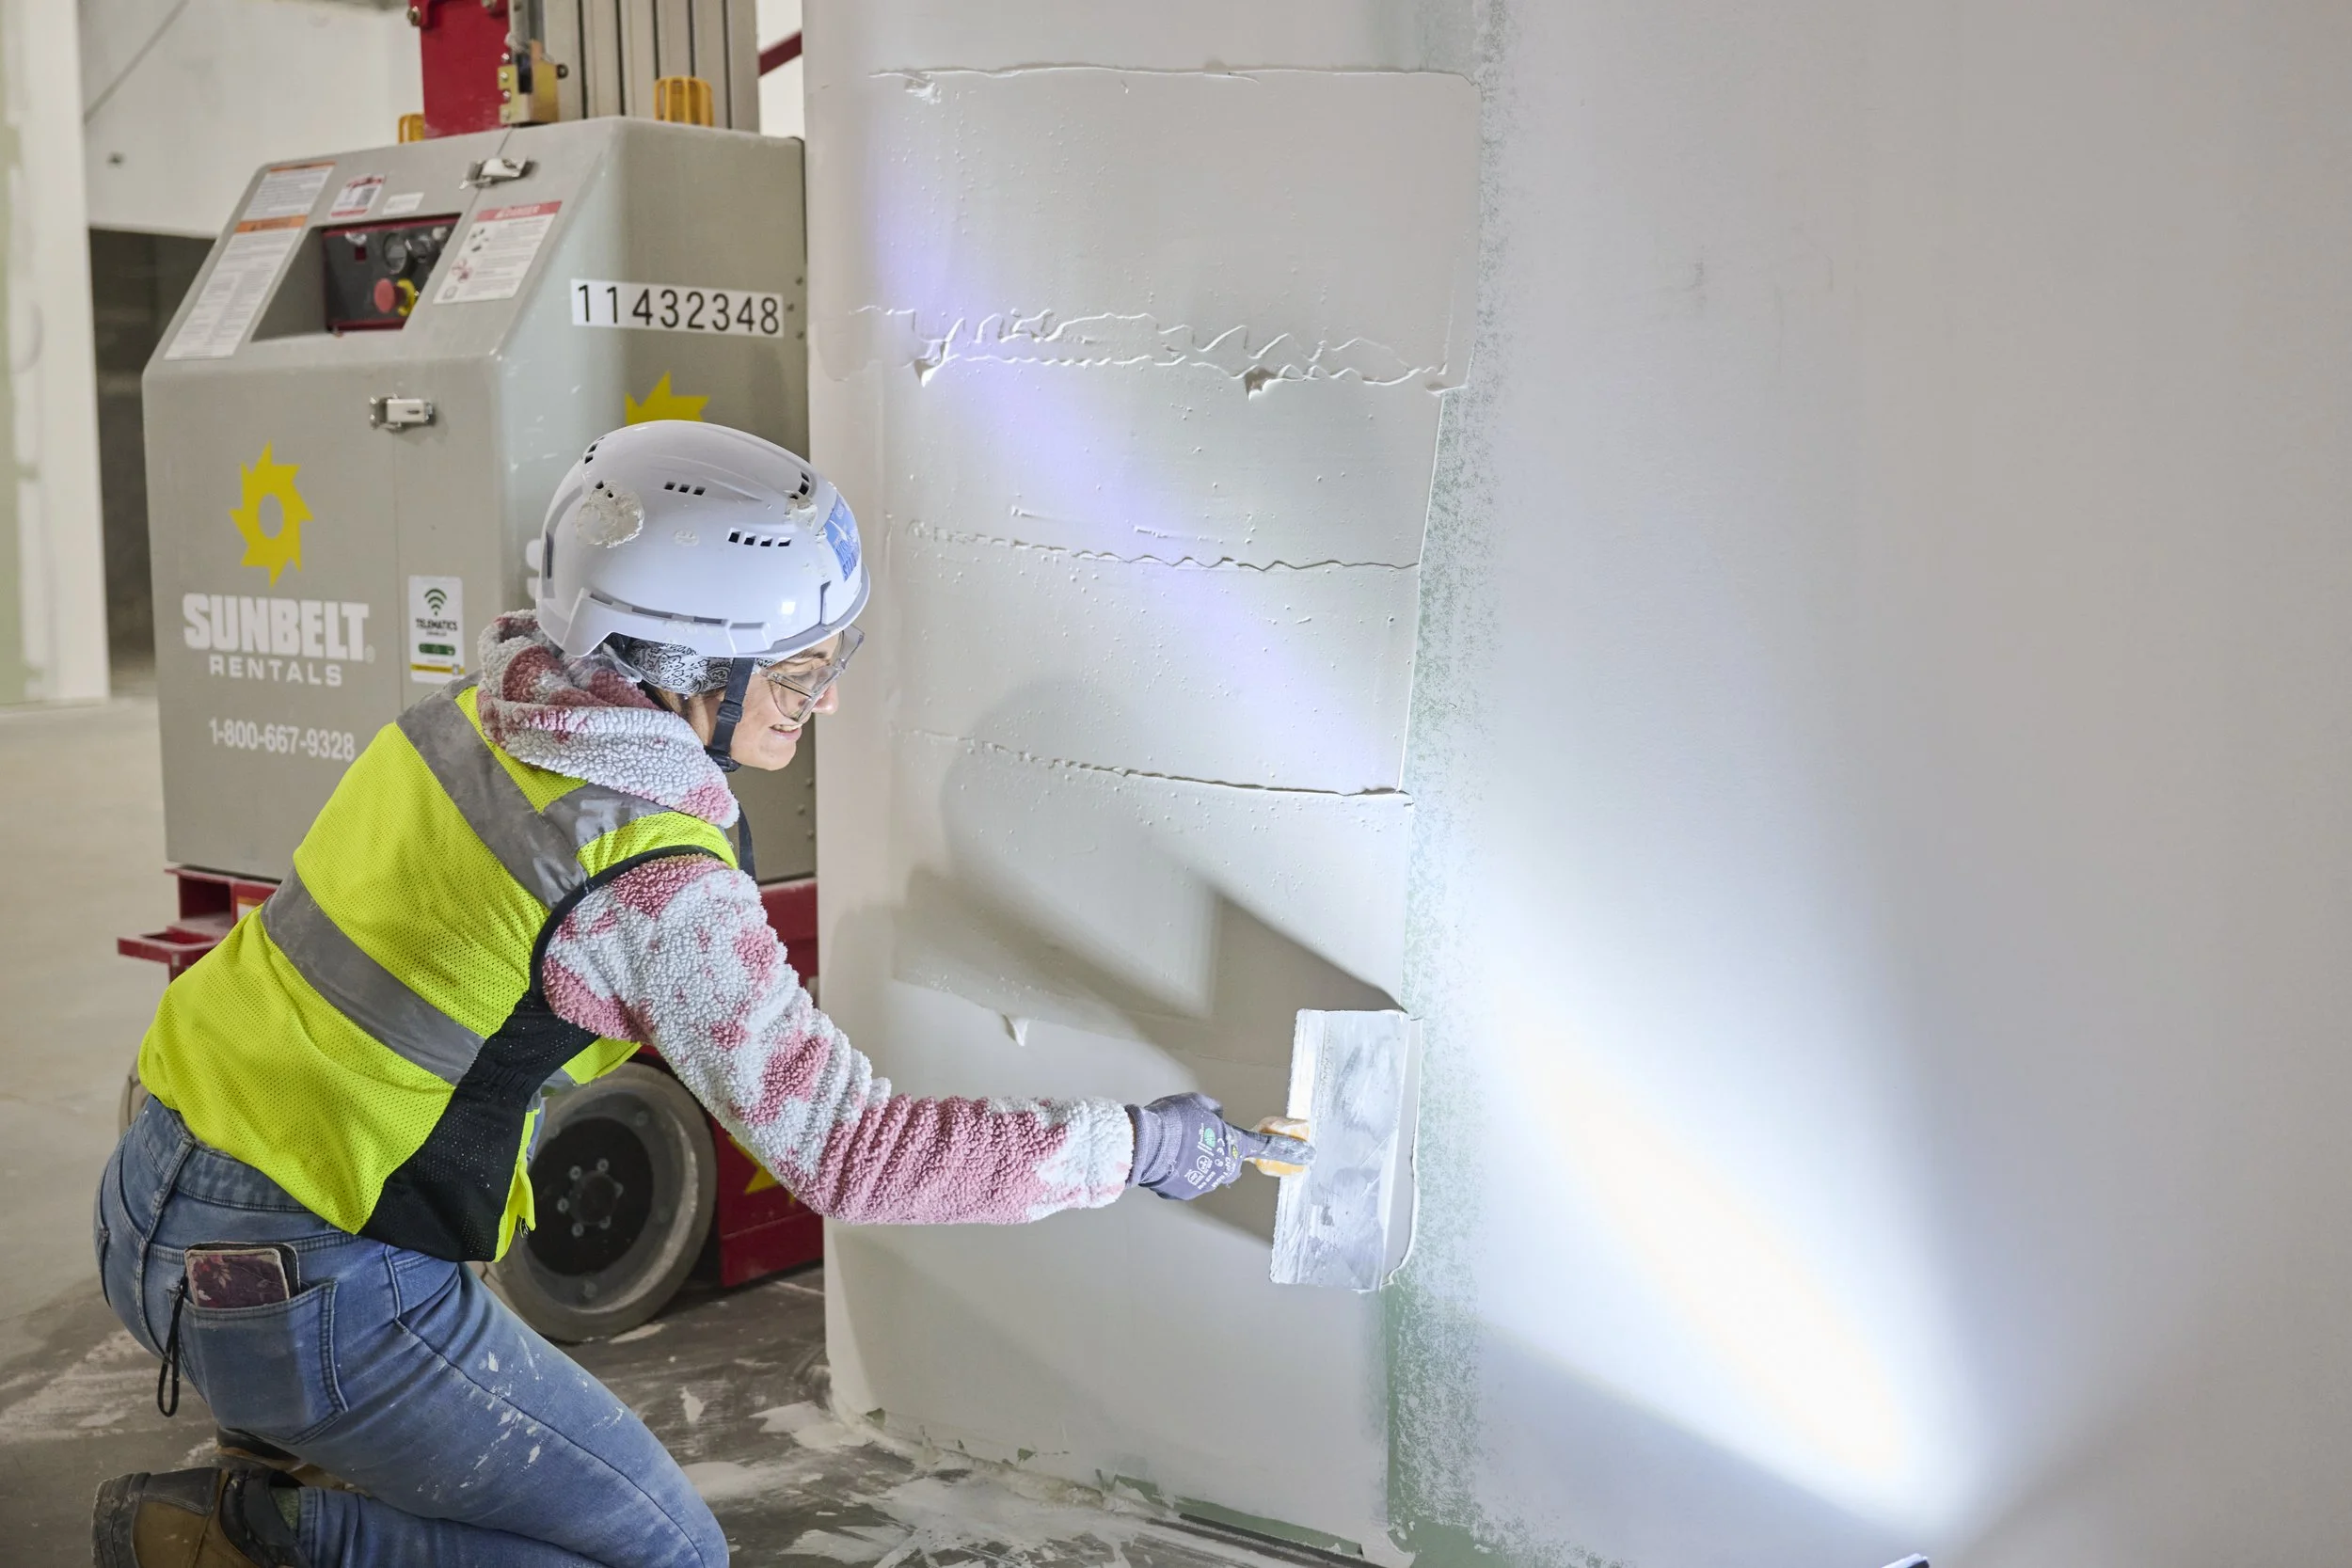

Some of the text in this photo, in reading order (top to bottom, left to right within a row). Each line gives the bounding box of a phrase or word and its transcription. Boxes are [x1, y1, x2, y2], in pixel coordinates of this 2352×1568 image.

[578, 284, 780, 335] 11432348
[183, 593, 370, 661] SUNBELT
[416, 617, 458, 631] TELEMATICS
[209, 655, 342, 687] RENTALS
[209, 718, 356, 761] 1-800-667-9328
